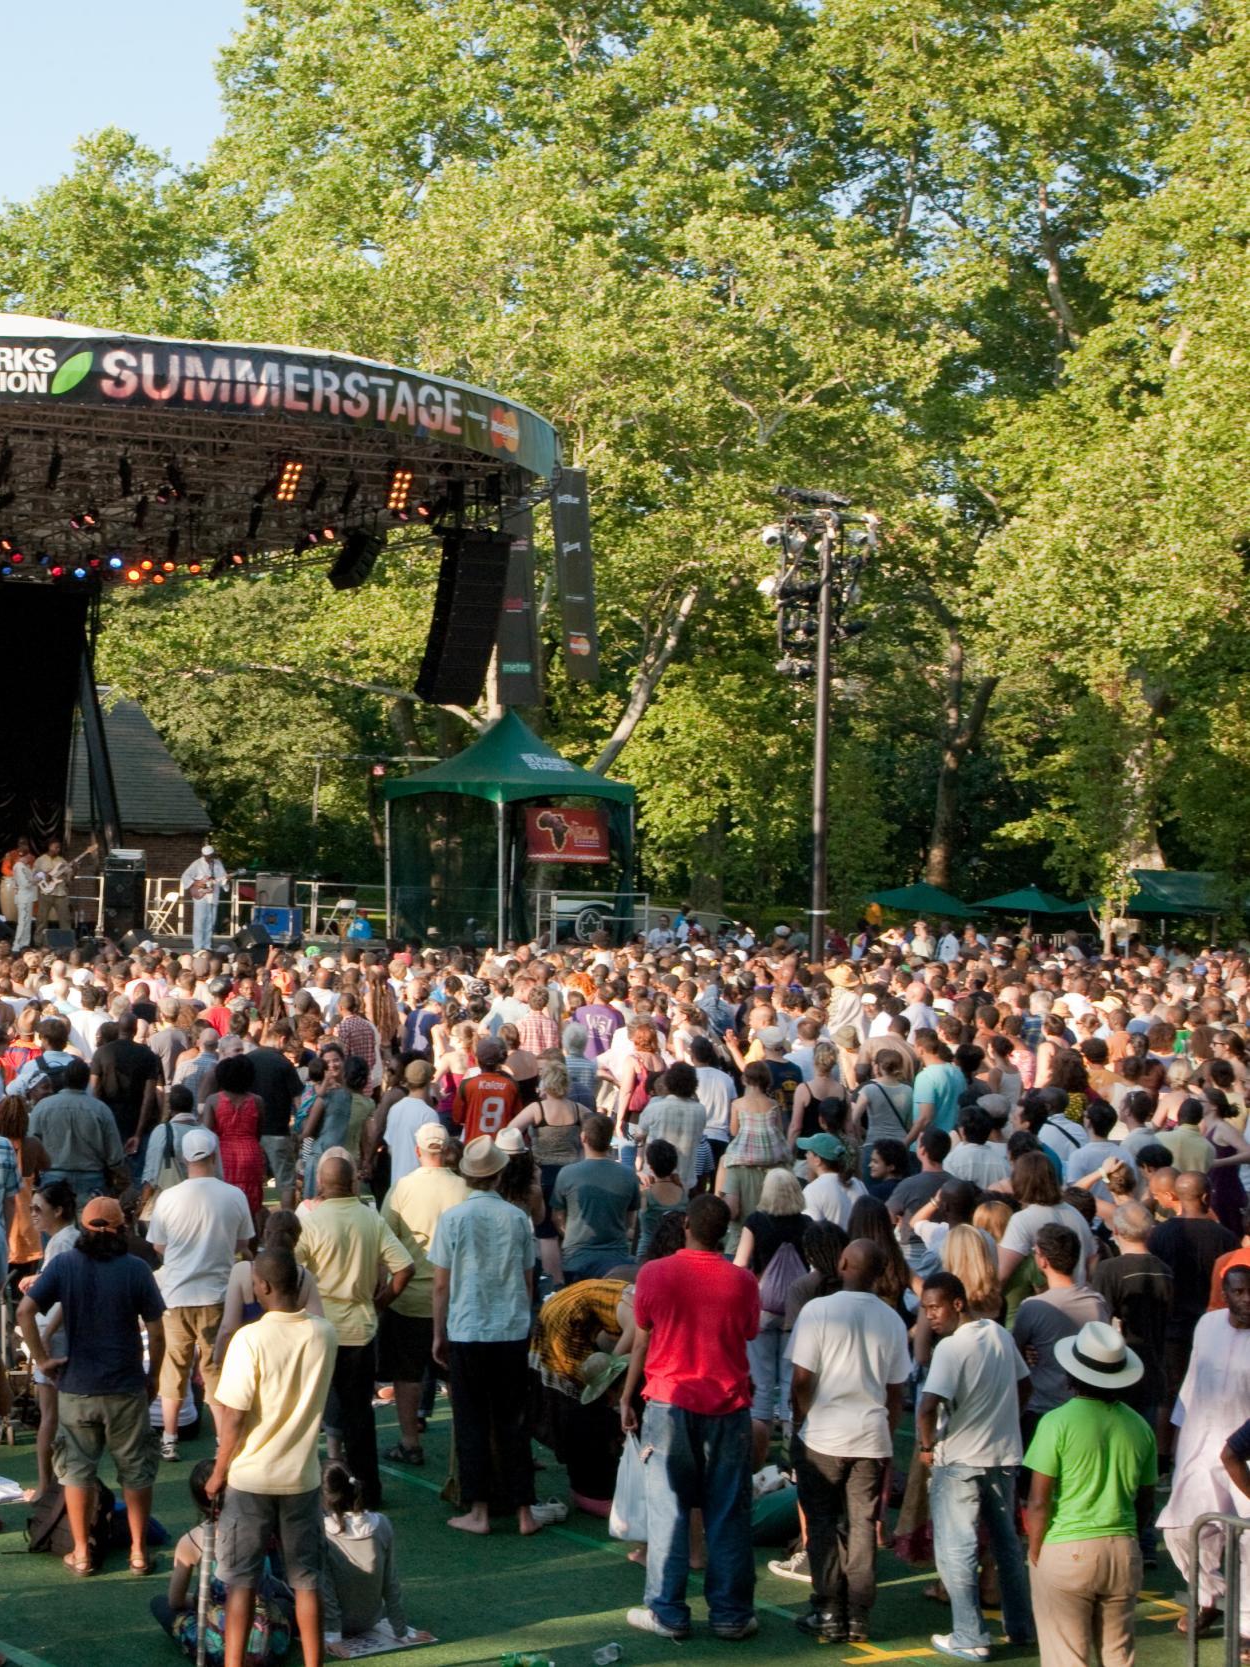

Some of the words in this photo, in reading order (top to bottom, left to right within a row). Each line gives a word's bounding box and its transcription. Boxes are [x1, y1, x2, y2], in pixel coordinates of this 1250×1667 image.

[100, 350, 463, 435] SUMMERSTAGE
[502, 662, 531, 673] metro
[478, 1080, 507, 1090] Kalou
[479, 1096, 505, 1133] 8
